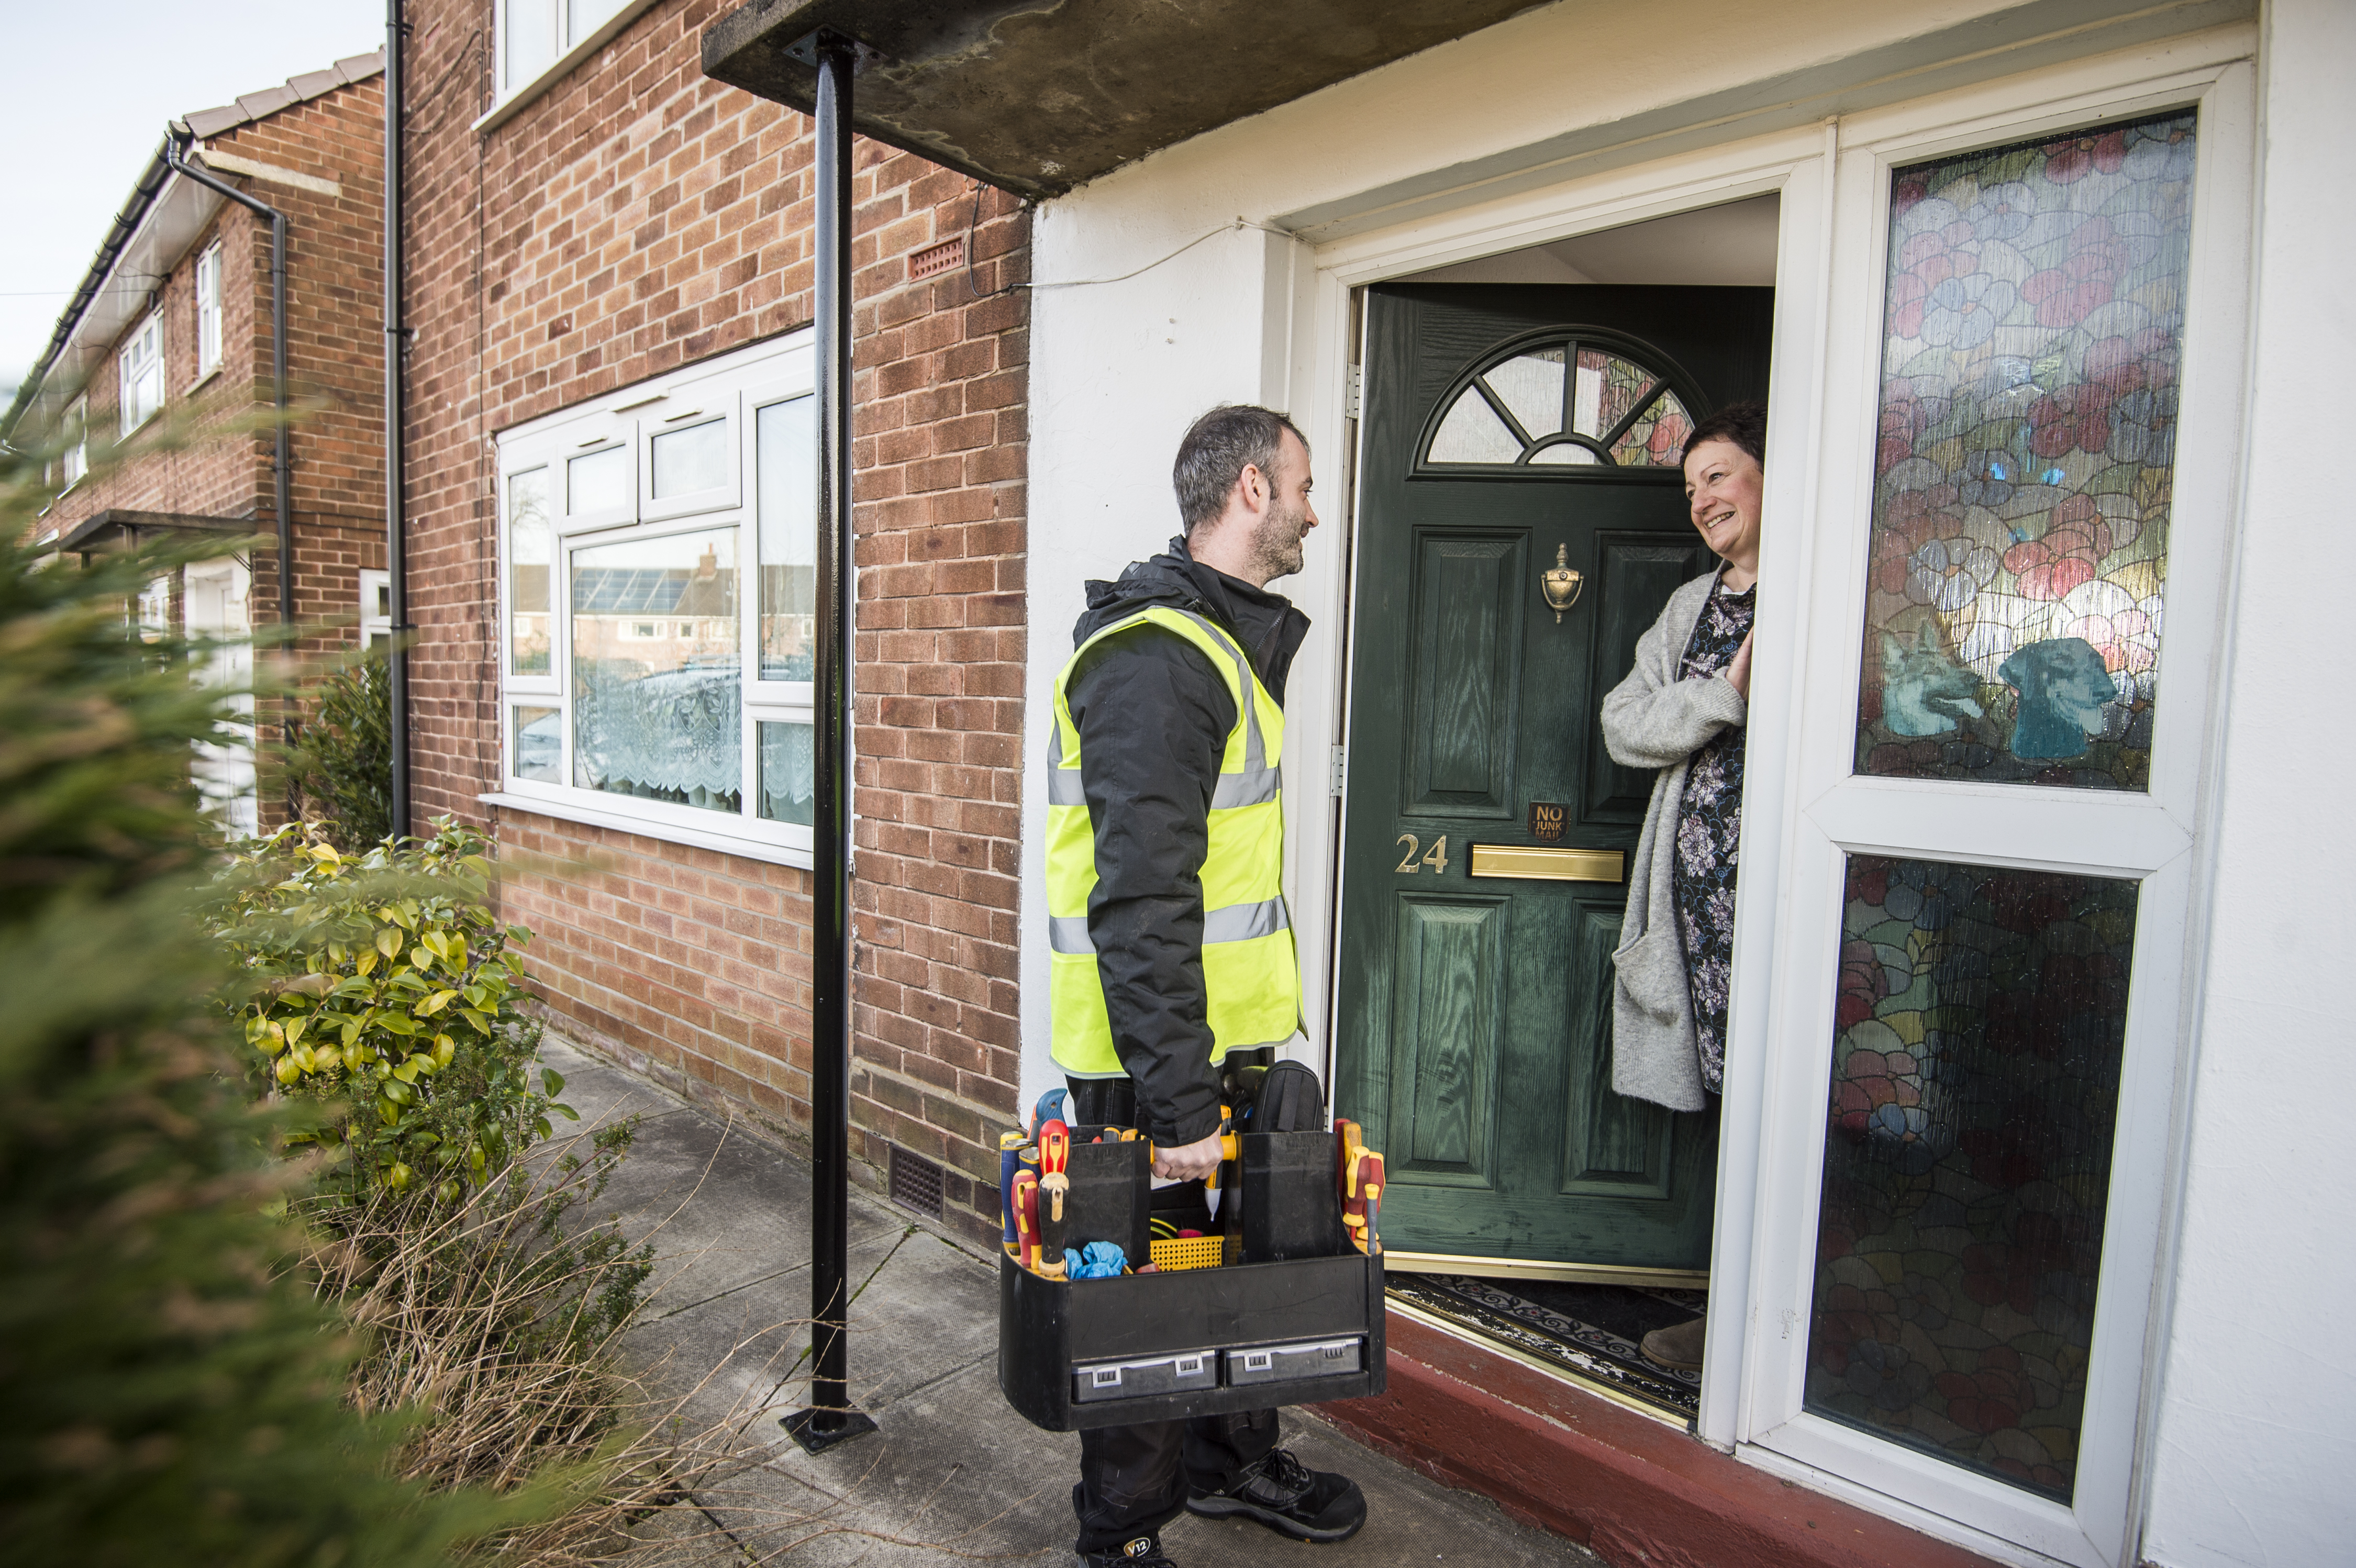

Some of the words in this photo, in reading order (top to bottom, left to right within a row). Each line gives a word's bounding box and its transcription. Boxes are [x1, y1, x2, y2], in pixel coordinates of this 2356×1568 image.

[1537, 806, 1562, 821] NO
[1536, 821, 1562, 831] JUNK
[1394, 833, 1448, 874] 24
[1127, 1541, 1147, 1554] V12
